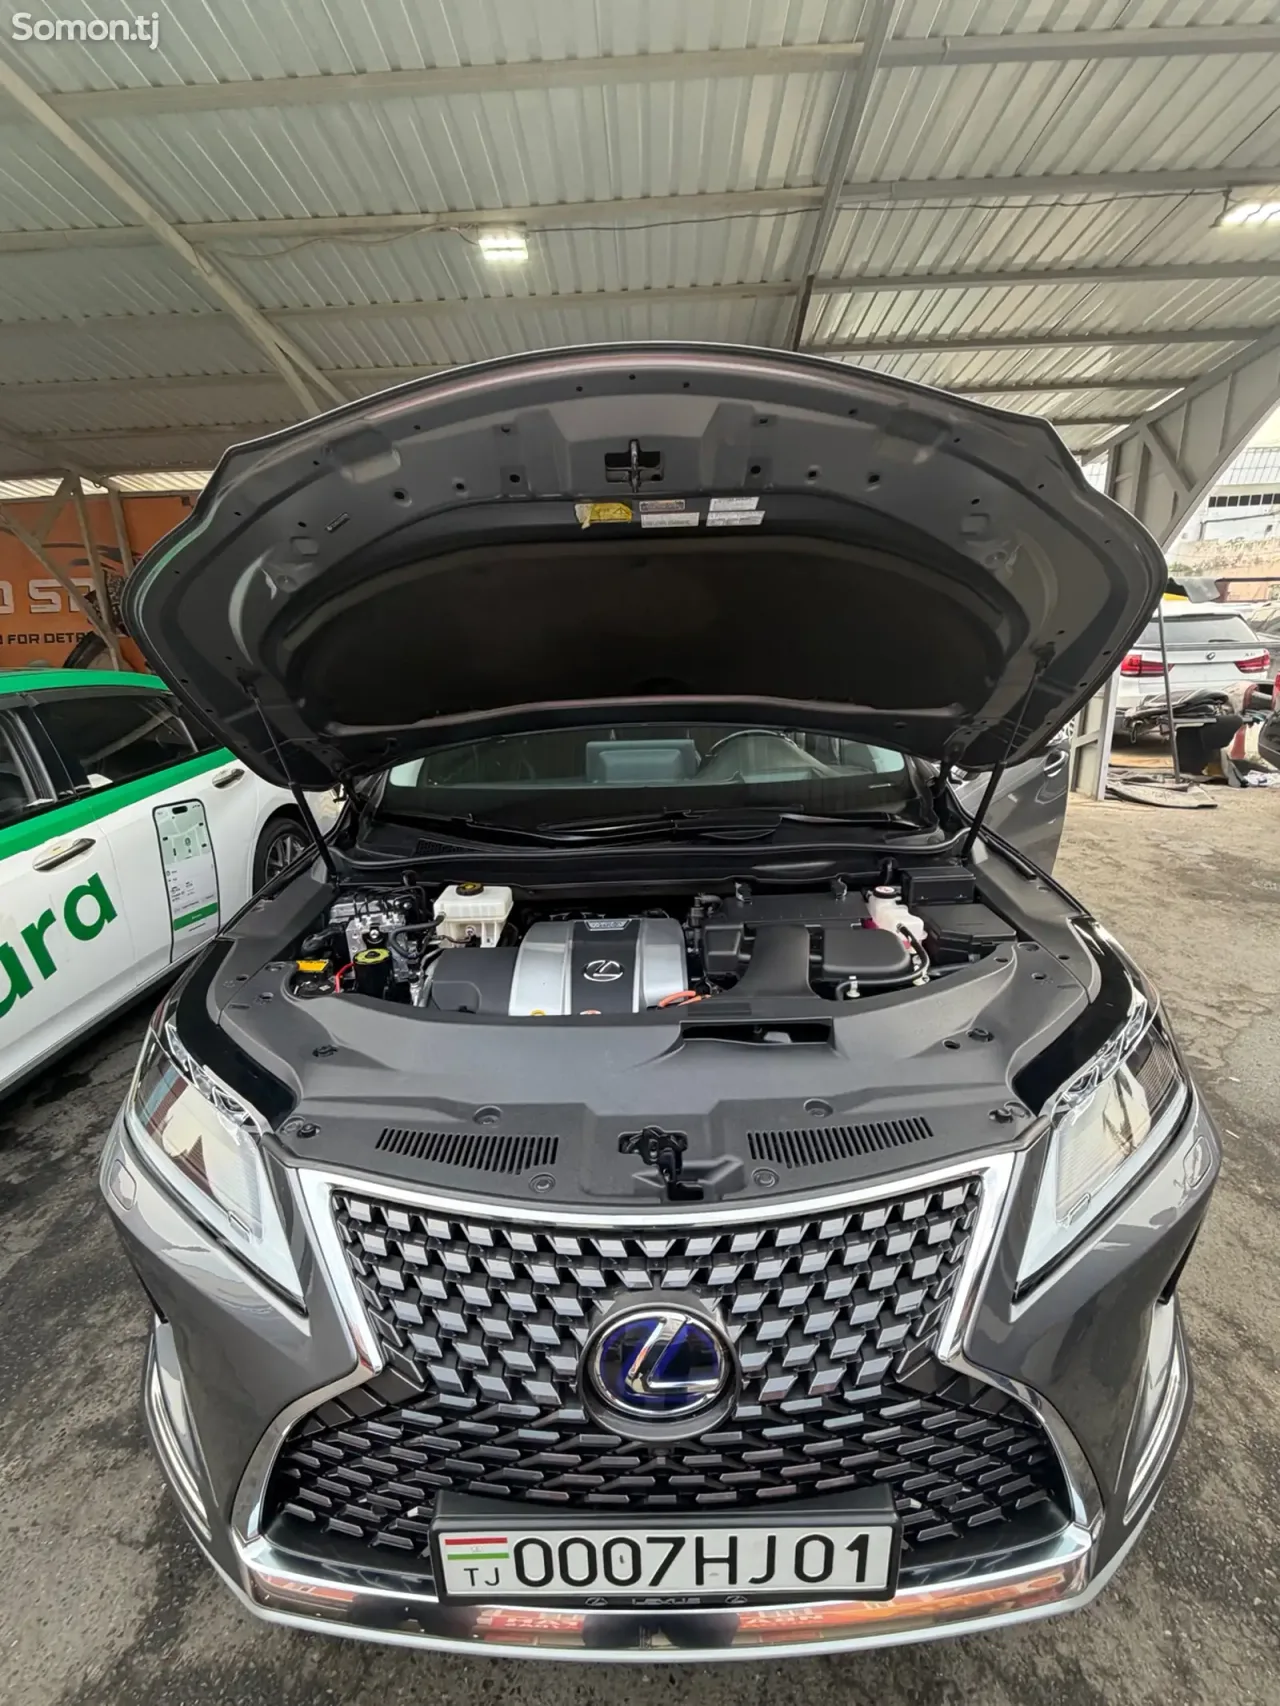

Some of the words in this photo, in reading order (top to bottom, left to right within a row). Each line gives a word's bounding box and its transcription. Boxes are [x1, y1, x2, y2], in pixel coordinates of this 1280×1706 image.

[8, 633, 40, 645] FOR
[463, 1566, 501, 1587] TJ
[631, 1597, 701, 1606] LEXUS
